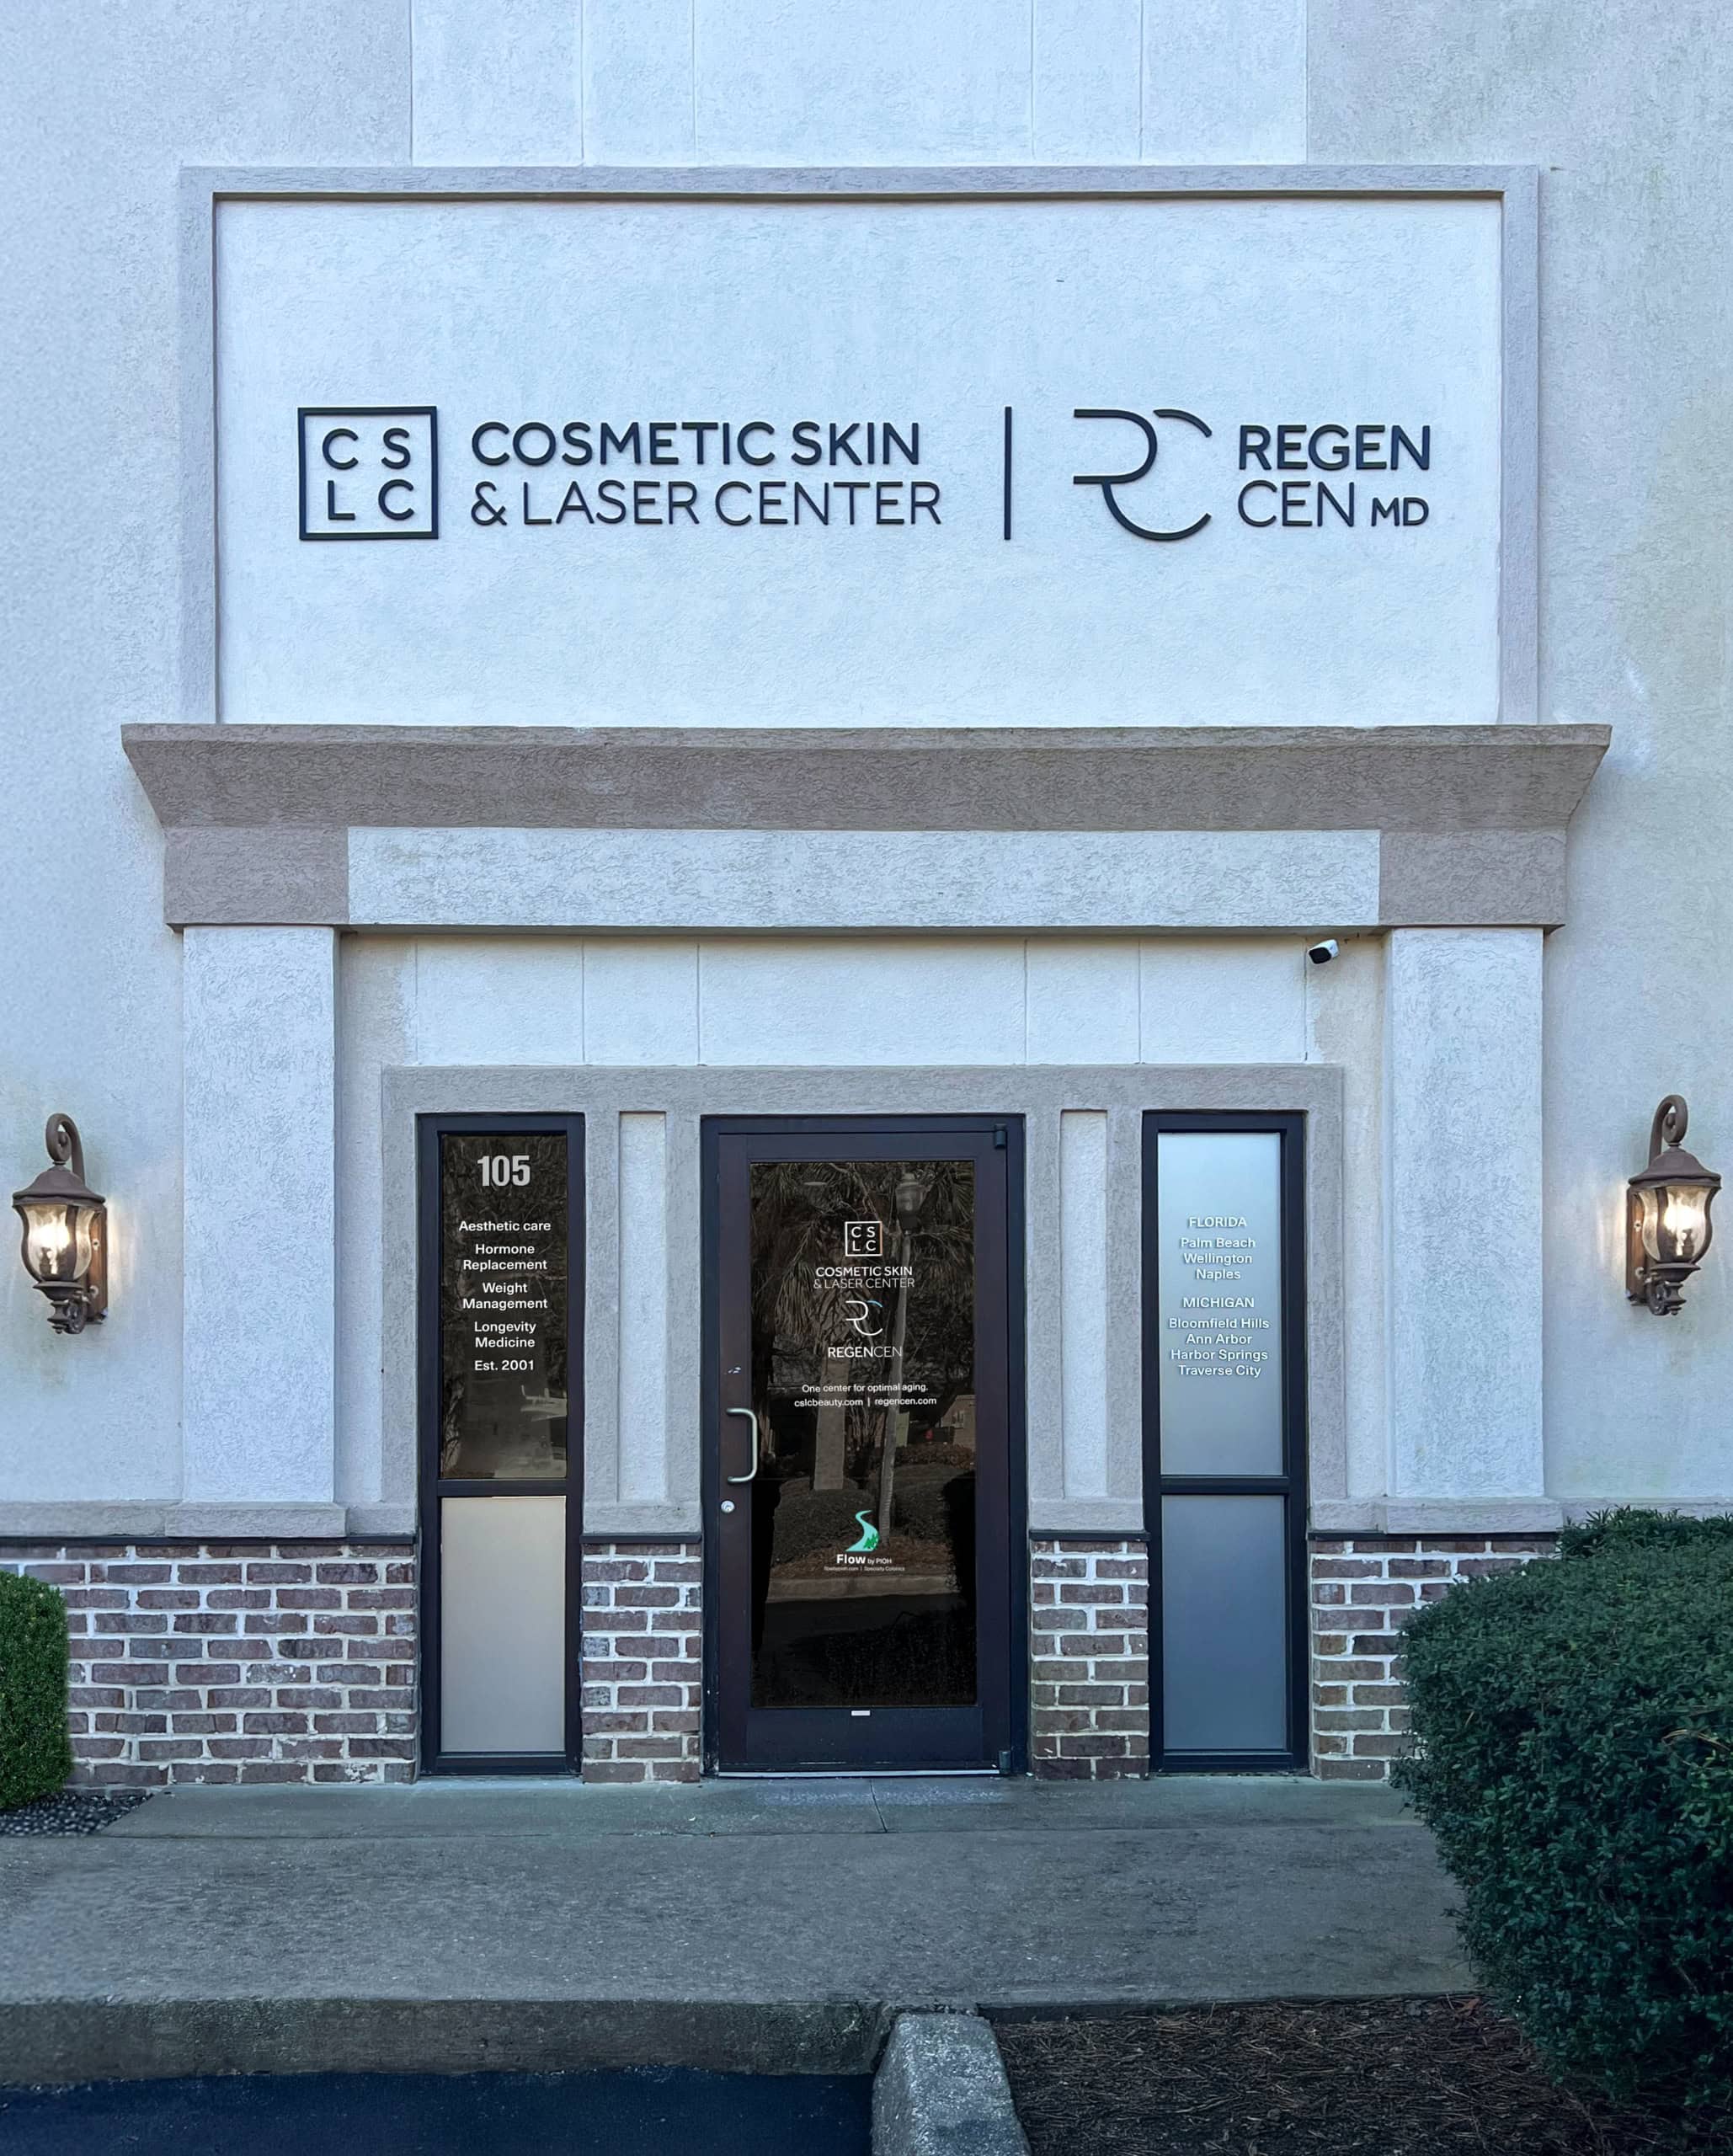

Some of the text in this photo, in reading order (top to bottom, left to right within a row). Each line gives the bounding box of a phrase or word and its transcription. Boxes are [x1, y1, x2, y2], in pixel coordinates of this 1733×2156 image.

[472, 421, 920, 467] COSMETIC SKIN
[1239, 424, 1431, 472] REGEN
[471, 479, 941, 526] & LASER CENTER
[1237, 479, 1430, 528] CEN MD
[477, 1155, 531, 1187] 105
[458, 1220, 552, 1231] Aesthetic care
[1188, 1216, 1248, 1228] FLORIDA
[1181, 1237, 1256, 1248] Palm Beach
[475, 1243, 536, 1255] Hormone
[1183, 1252, 1252, 1266] Wellington
[463, 1259, 547, 1273] Replacement
[816, 1266, 913, 1277] COSMETIC SKIN
[1196, 1268, 1241, 1282] Naples
[482, 1282, 528, 1295] Weight
[813, 1278, 914, 1289] & LASER CENTER
[462, 1298, 548, 1311] Management
[1182, 1298, 1255, 1308] MICHIGAN
[474, 1321, 536, 1335] Longevity
[1169, 1318, 1270, 1329] Bloomfield Hills
[475, 1337, 536, 1348] Medicine
[1186, 1334, 1253, 1345] Ann Arbor
[828, 1347, 902, 1358] REGENCEN
[1170, 1349, 1268, 1363] Harbor Springs
[474, 1359, 534, 1371] Est. 2001
[1178, 1364, 1261, 1378] Traverse City
[802, 1382, 929, 1394] One center for optimal aging.
[794, 1397, 864, 1407] cslcbeauty.com
[874, 1397, 937, 1406] regencen.com
[836, 1554, 866, 1564] Flow
[867, 1557, 875, 1566] by
